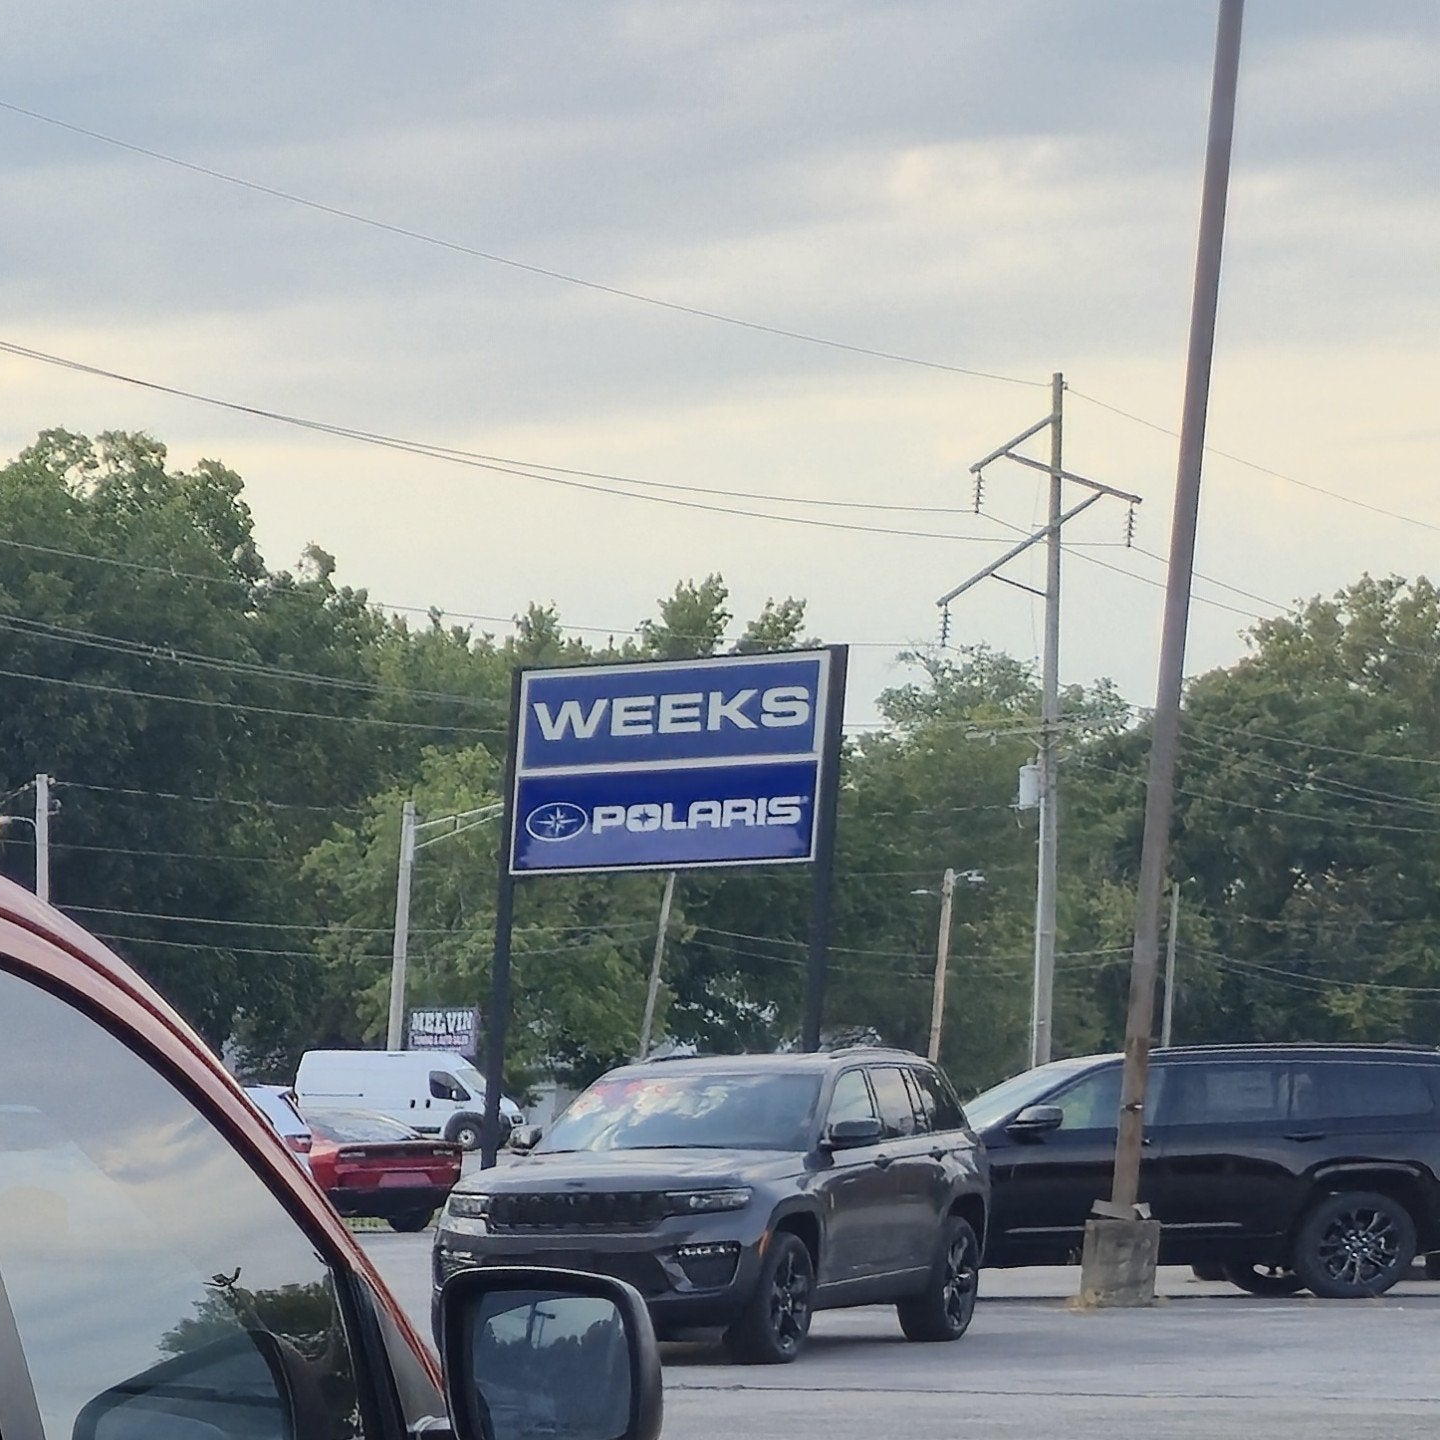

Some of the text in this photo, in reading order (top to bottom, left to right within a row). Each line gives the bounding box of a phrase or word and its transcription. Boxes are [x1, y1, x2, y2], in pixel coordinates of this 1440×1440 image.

[533, 685, 810, 741] WEEKS
[591, 796, 802, 835] POLARIS
[411, 1011, 474, 1034] MELVIN
